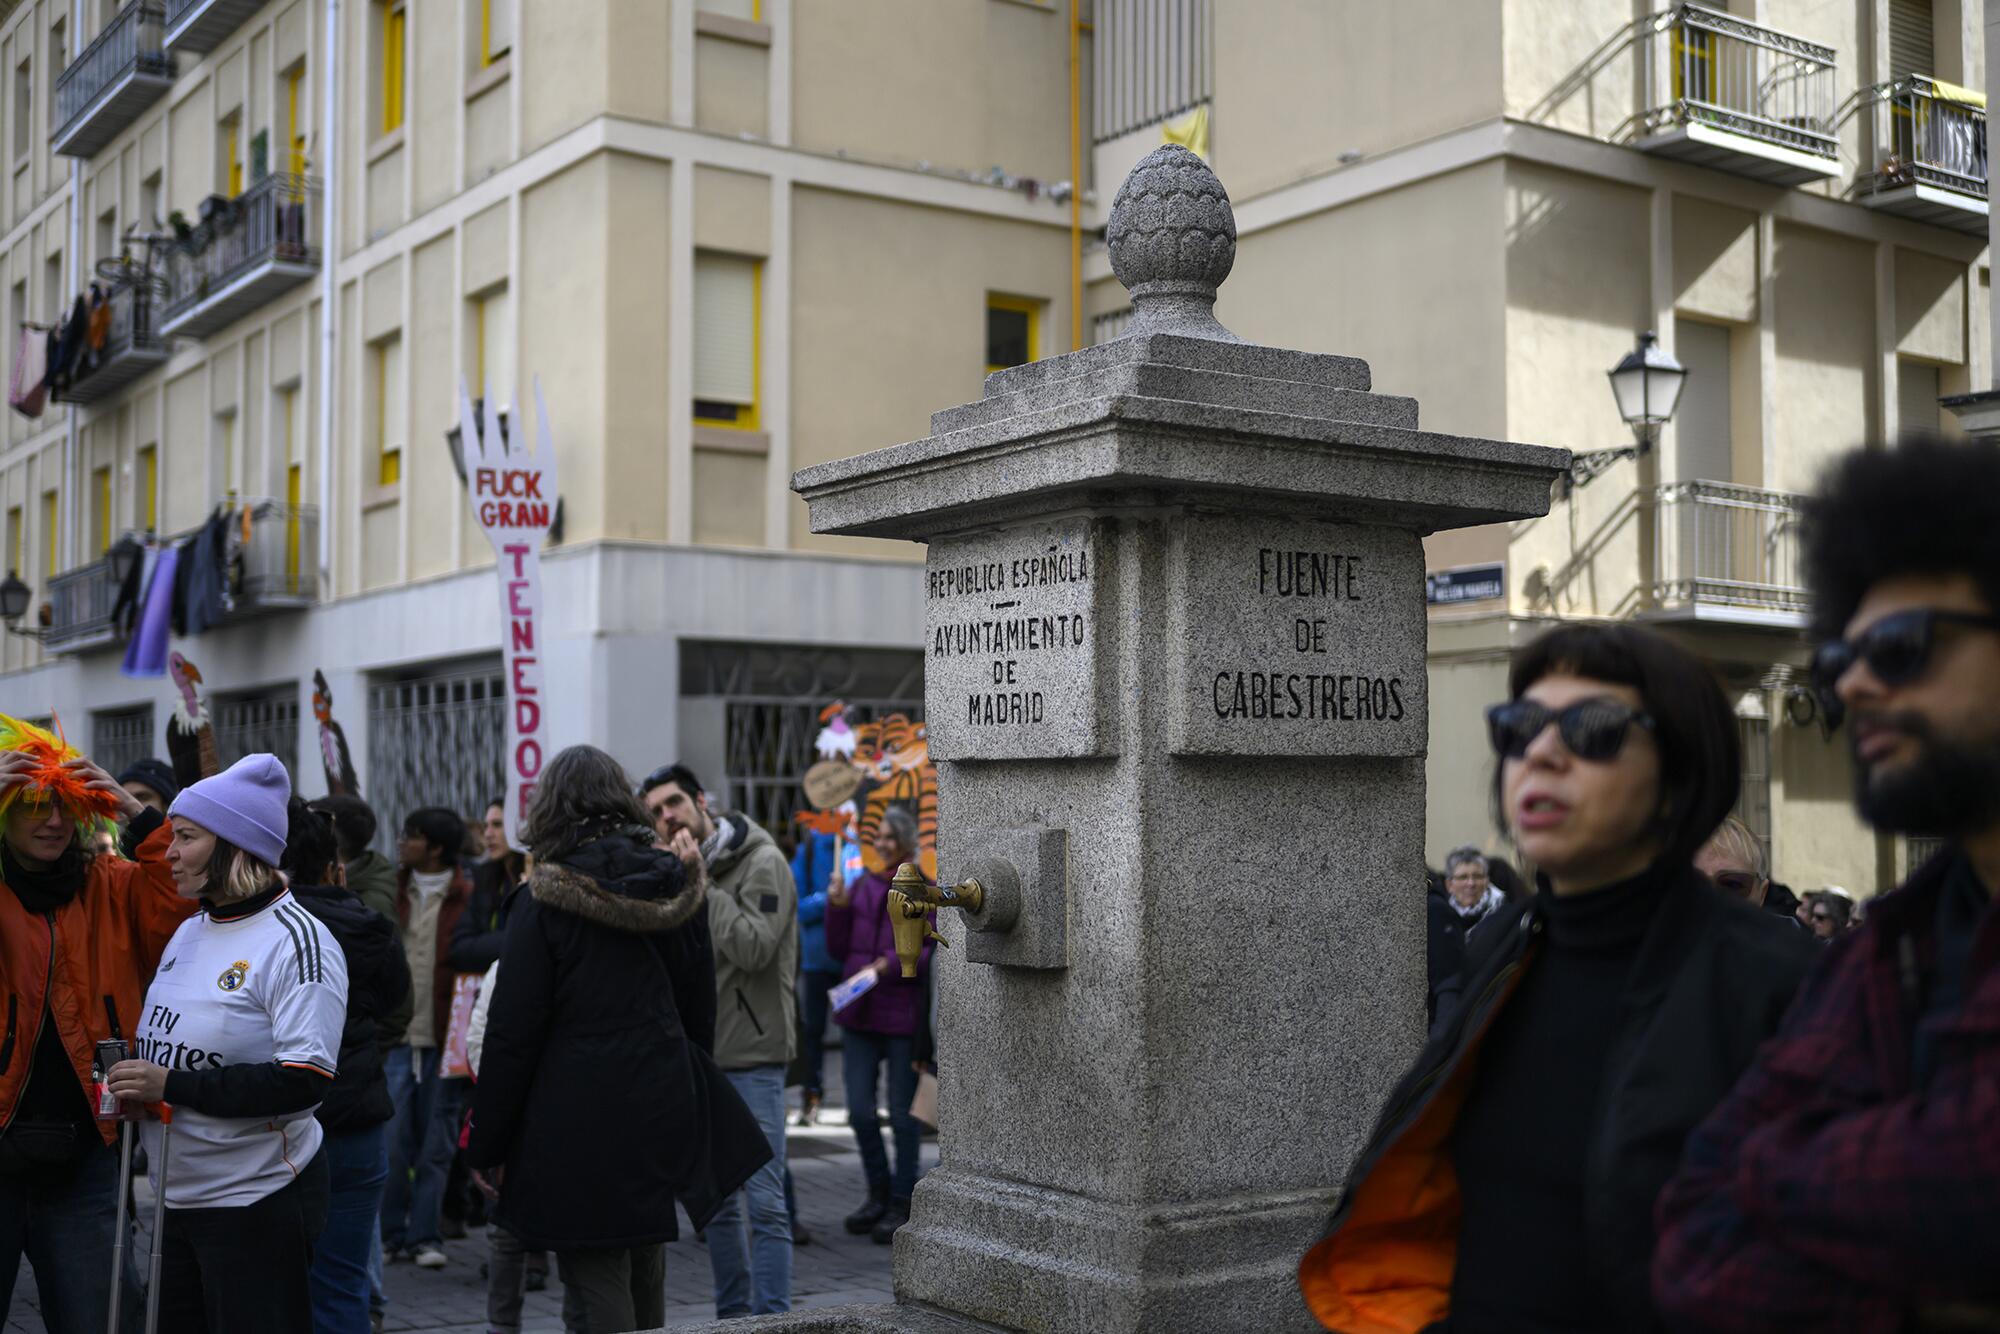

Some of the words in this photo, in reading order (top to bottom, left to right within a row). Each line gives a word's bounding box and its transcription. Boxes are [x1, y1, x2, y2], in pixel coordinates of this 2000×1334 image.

[476, 467, 543, 500] FUCK
[480, 501, 550, 528] GRAN
[930, 563, 1005, 599] REPUBLICA
[1013, 545, 1088, 588] ESPAÑOLA
[1259, 548, 1361, 601] FUENTE
[934, 614, 1084, 657] AYUNTAMIENTO
[1295, 618, 1327, 653] DE
[993, 660, 1018, 684] DE
[968, 692, 1044, 726] MADRID
[1213, 671, 1405, 721] CABESTREROS
[148, 1005, 181, 1035] Fly
[135, 1031, 224, 1072] mirates
